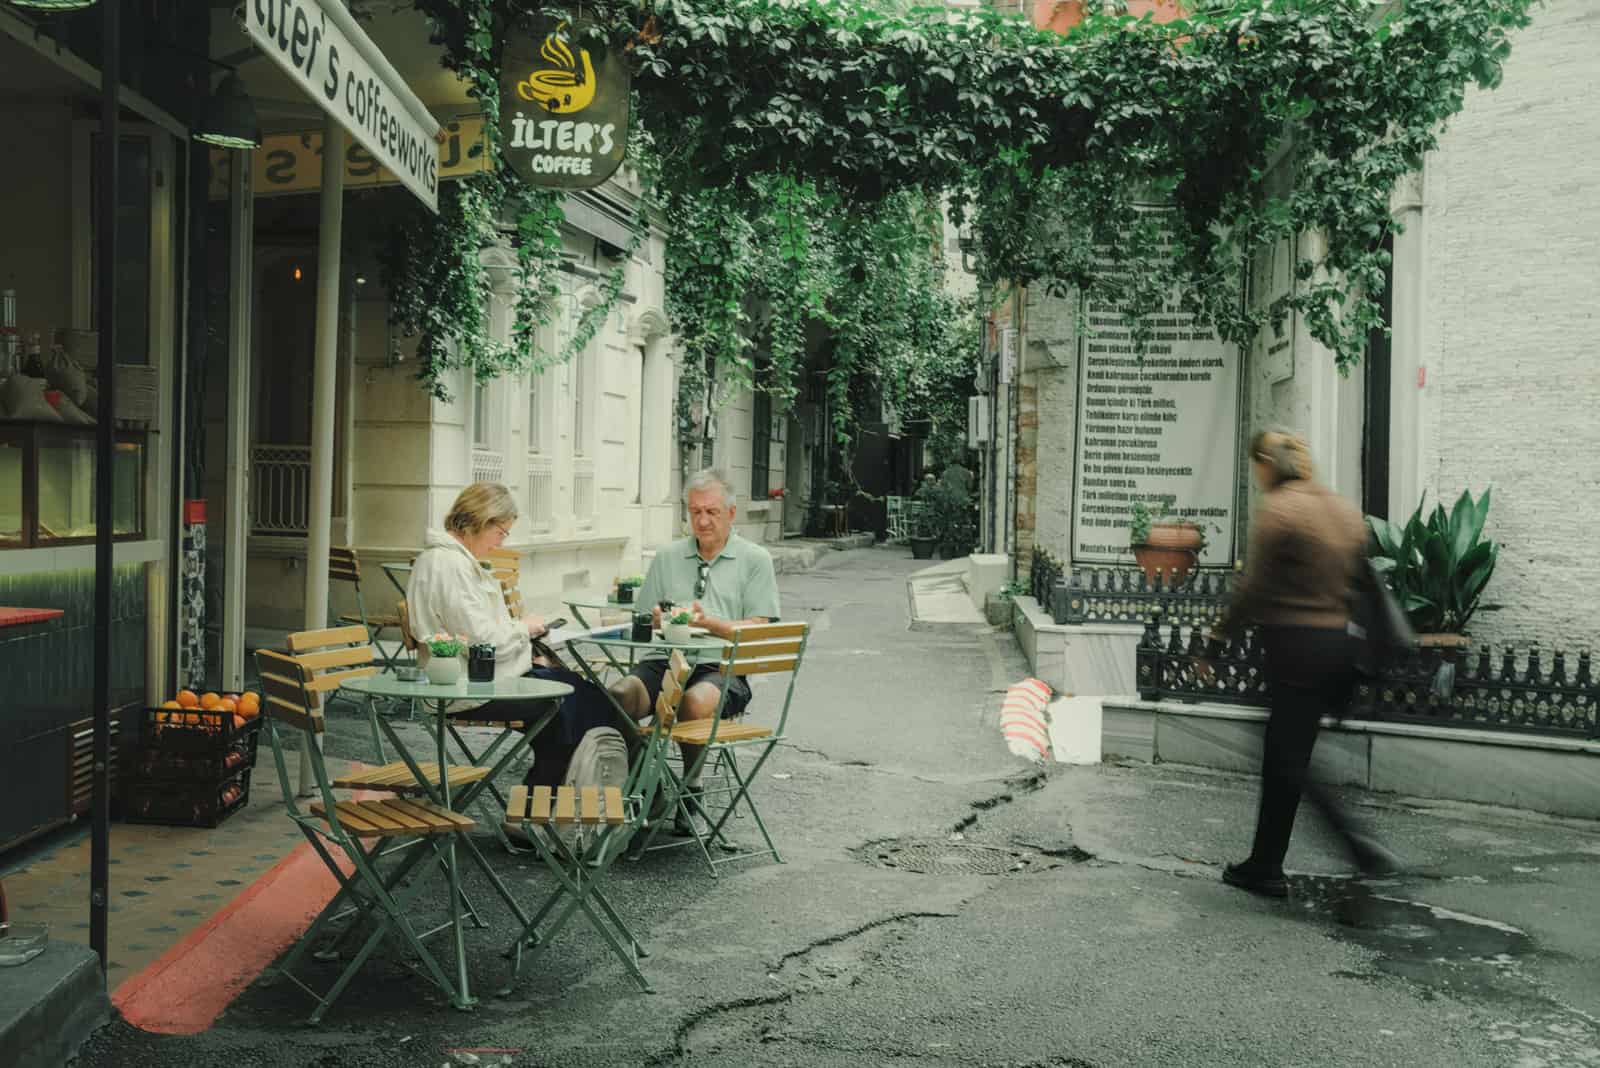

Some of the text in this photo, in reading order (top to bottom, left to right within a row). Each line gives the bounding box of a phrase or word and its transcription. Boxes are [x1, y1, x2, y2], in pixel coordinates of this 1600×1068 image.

[346, 70, 436, 195] coffeeworks
[510, 112, 615, 155] İLTER'S
[532, 153, 593, 176] COFFEE
